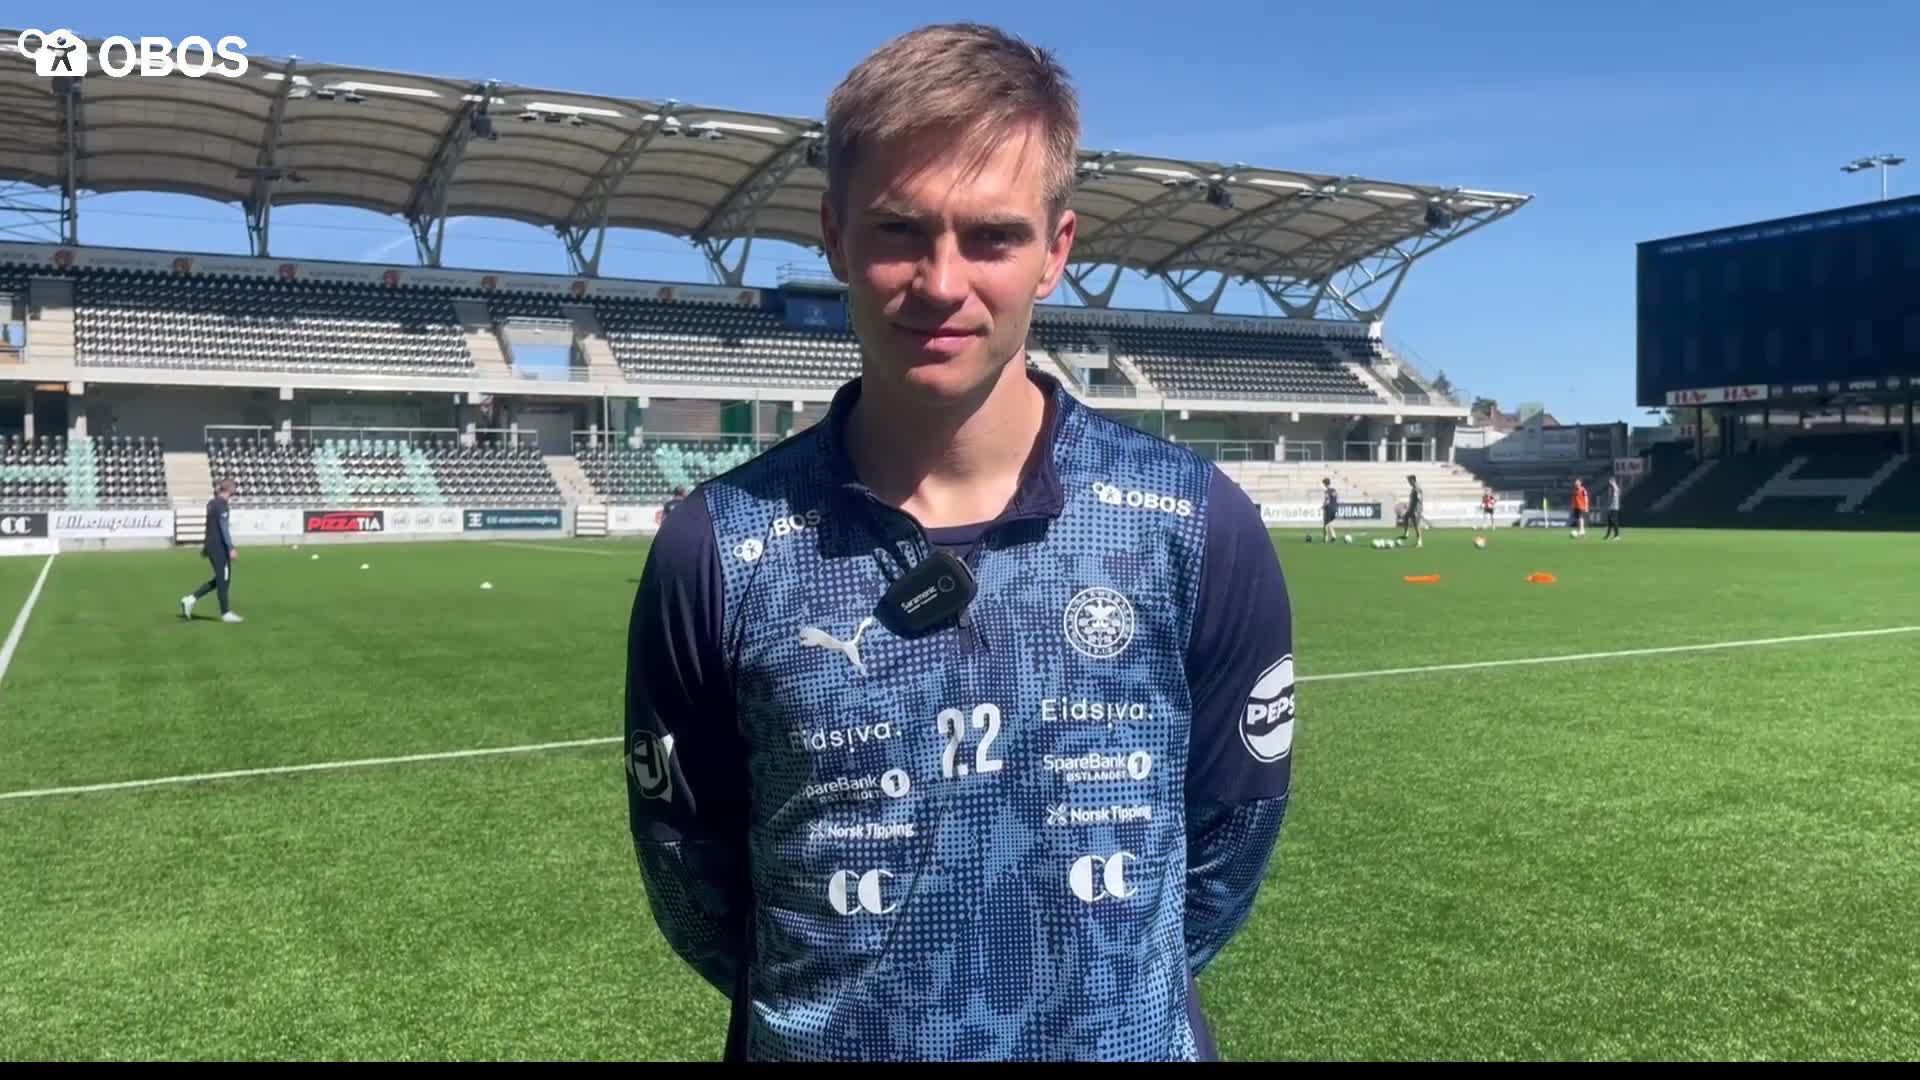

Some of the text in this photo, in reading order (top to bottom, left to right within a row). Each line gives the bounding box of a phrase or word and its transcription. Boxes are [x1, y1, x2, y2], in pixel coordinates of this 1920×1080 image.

[1126, 489, 1193, 517] OBOS
[768, 509, 822, 541] BOS
[1043, 753, 1126, 773] SpareBank
[1070, 804, 1152, 822] Norsk Tipping
[828, 821, 915, 839] Norsk Tipping
